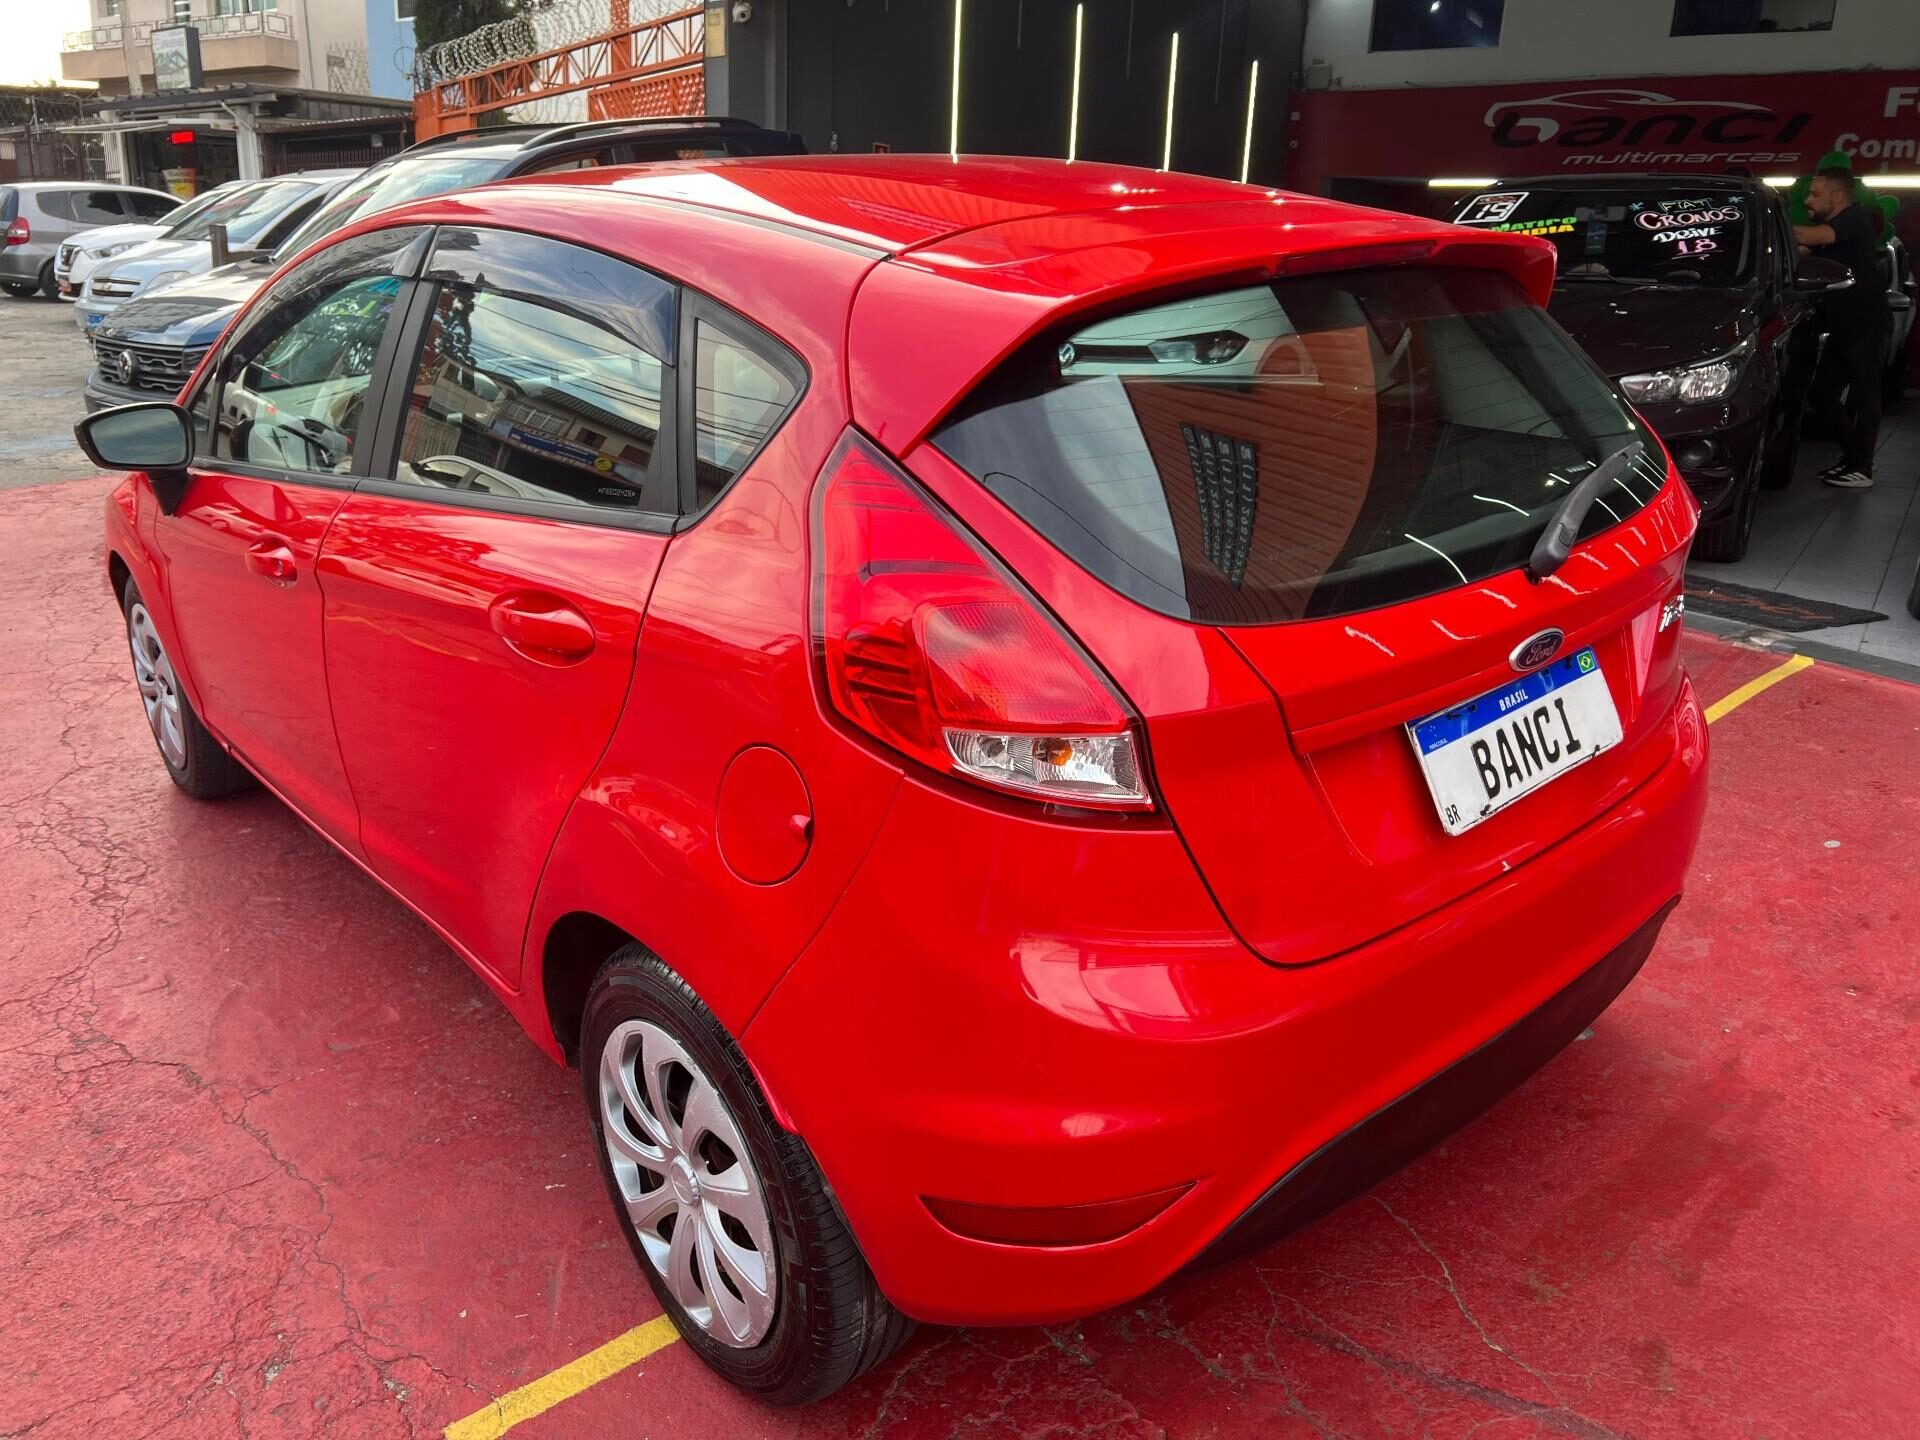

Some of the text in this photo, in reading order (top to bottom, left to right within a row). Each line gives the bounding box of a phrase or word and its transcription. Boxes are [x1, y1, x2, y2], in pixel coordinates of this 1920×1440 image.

[1884, 86, 1920, 117] F
[1562, 151, 1803, 165] multimarcas
[1834, 133, 1920, 165] Com
[1661, 199, 1706, 211] FIAT
[1638, 206, 1741, 230] CRONOS
[1526, 639, 1557, 666] Ford
[1499, 689, 1529, 712] BRASIL
[1471, 697, 1582, 799] BANCI
[1445, 804, 1461, 825] BR
